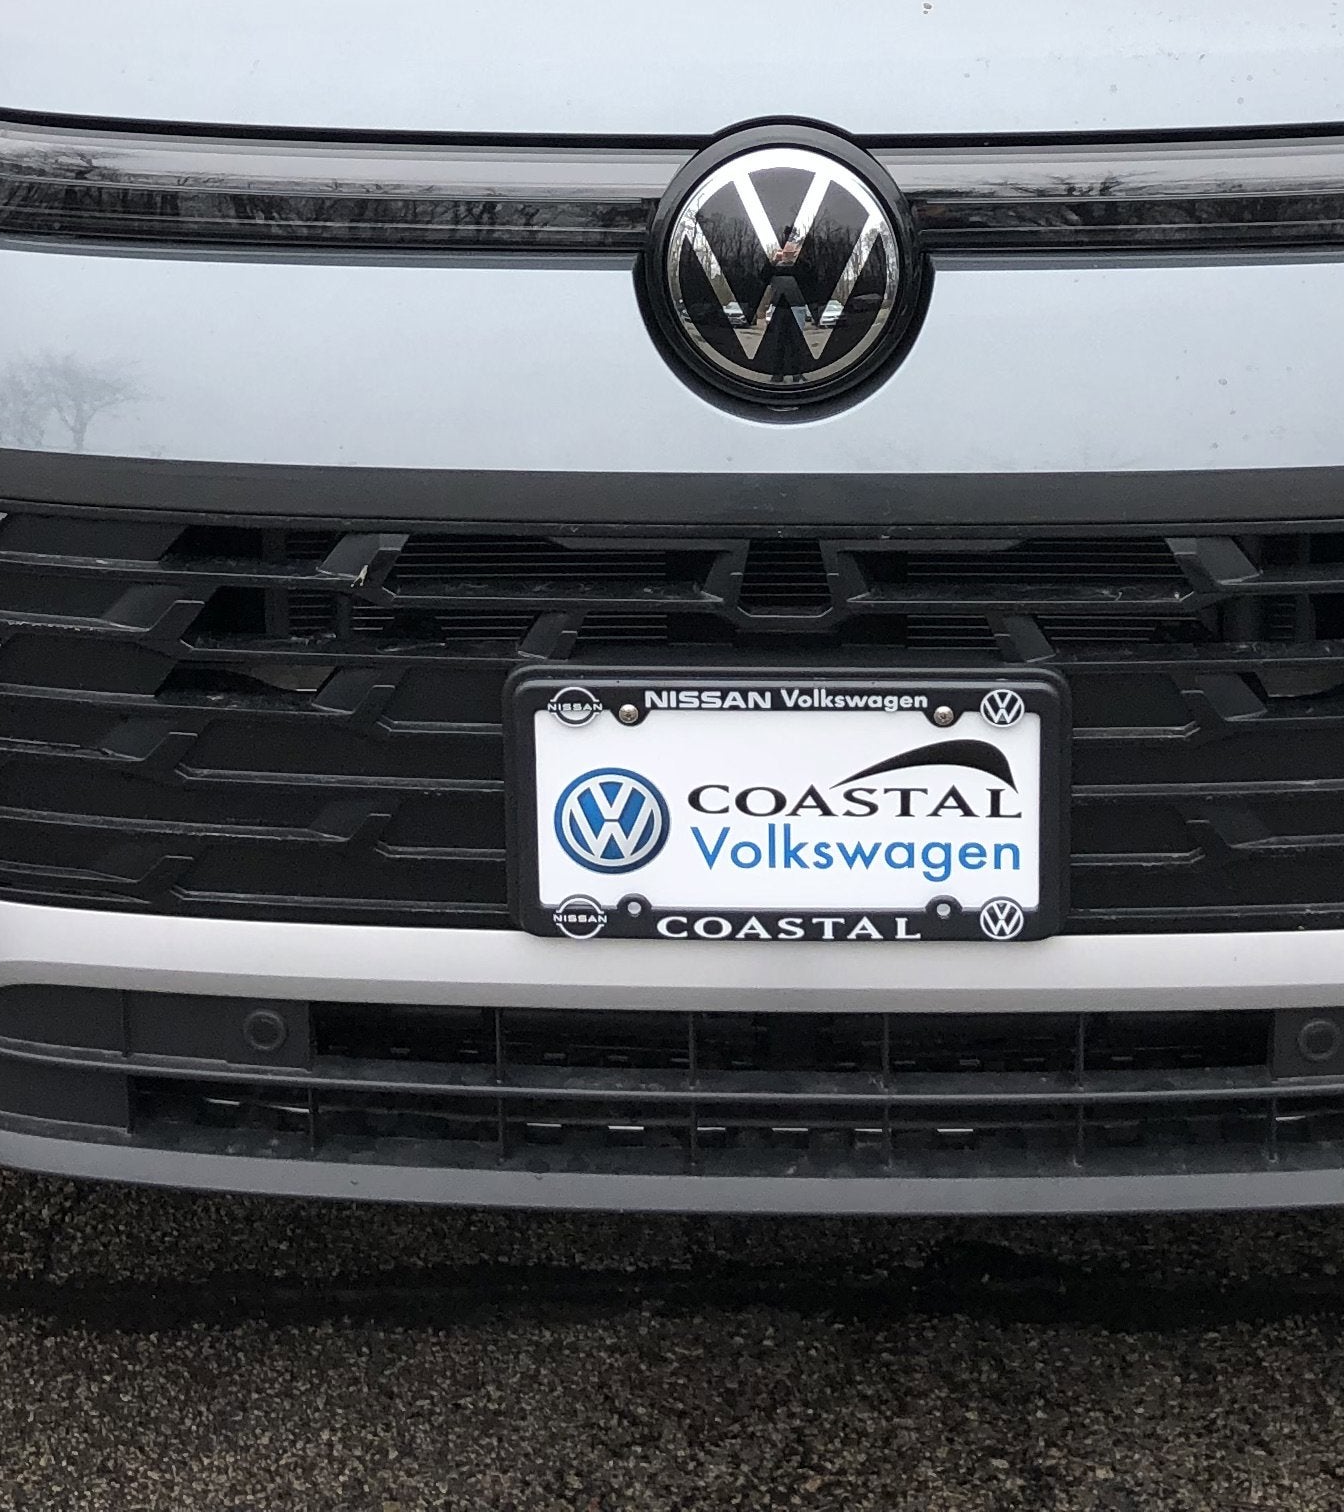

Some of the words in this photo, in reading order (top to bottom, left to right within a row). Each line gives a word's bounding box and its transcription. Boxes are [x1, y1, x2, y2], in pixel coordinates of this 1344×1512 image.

[547, 702, 603, 711] NISSAN
[644, 690, 772, 709] NISSAN
[780, 688, 929, 713] Volkswagen
[687, 783, 1023, 819] COASTAL
[690, 822, 1021, 883] Volkswagen
[552, 913, 608, 924] NISSAN
[656, 915, 922, 940] COASTAL
